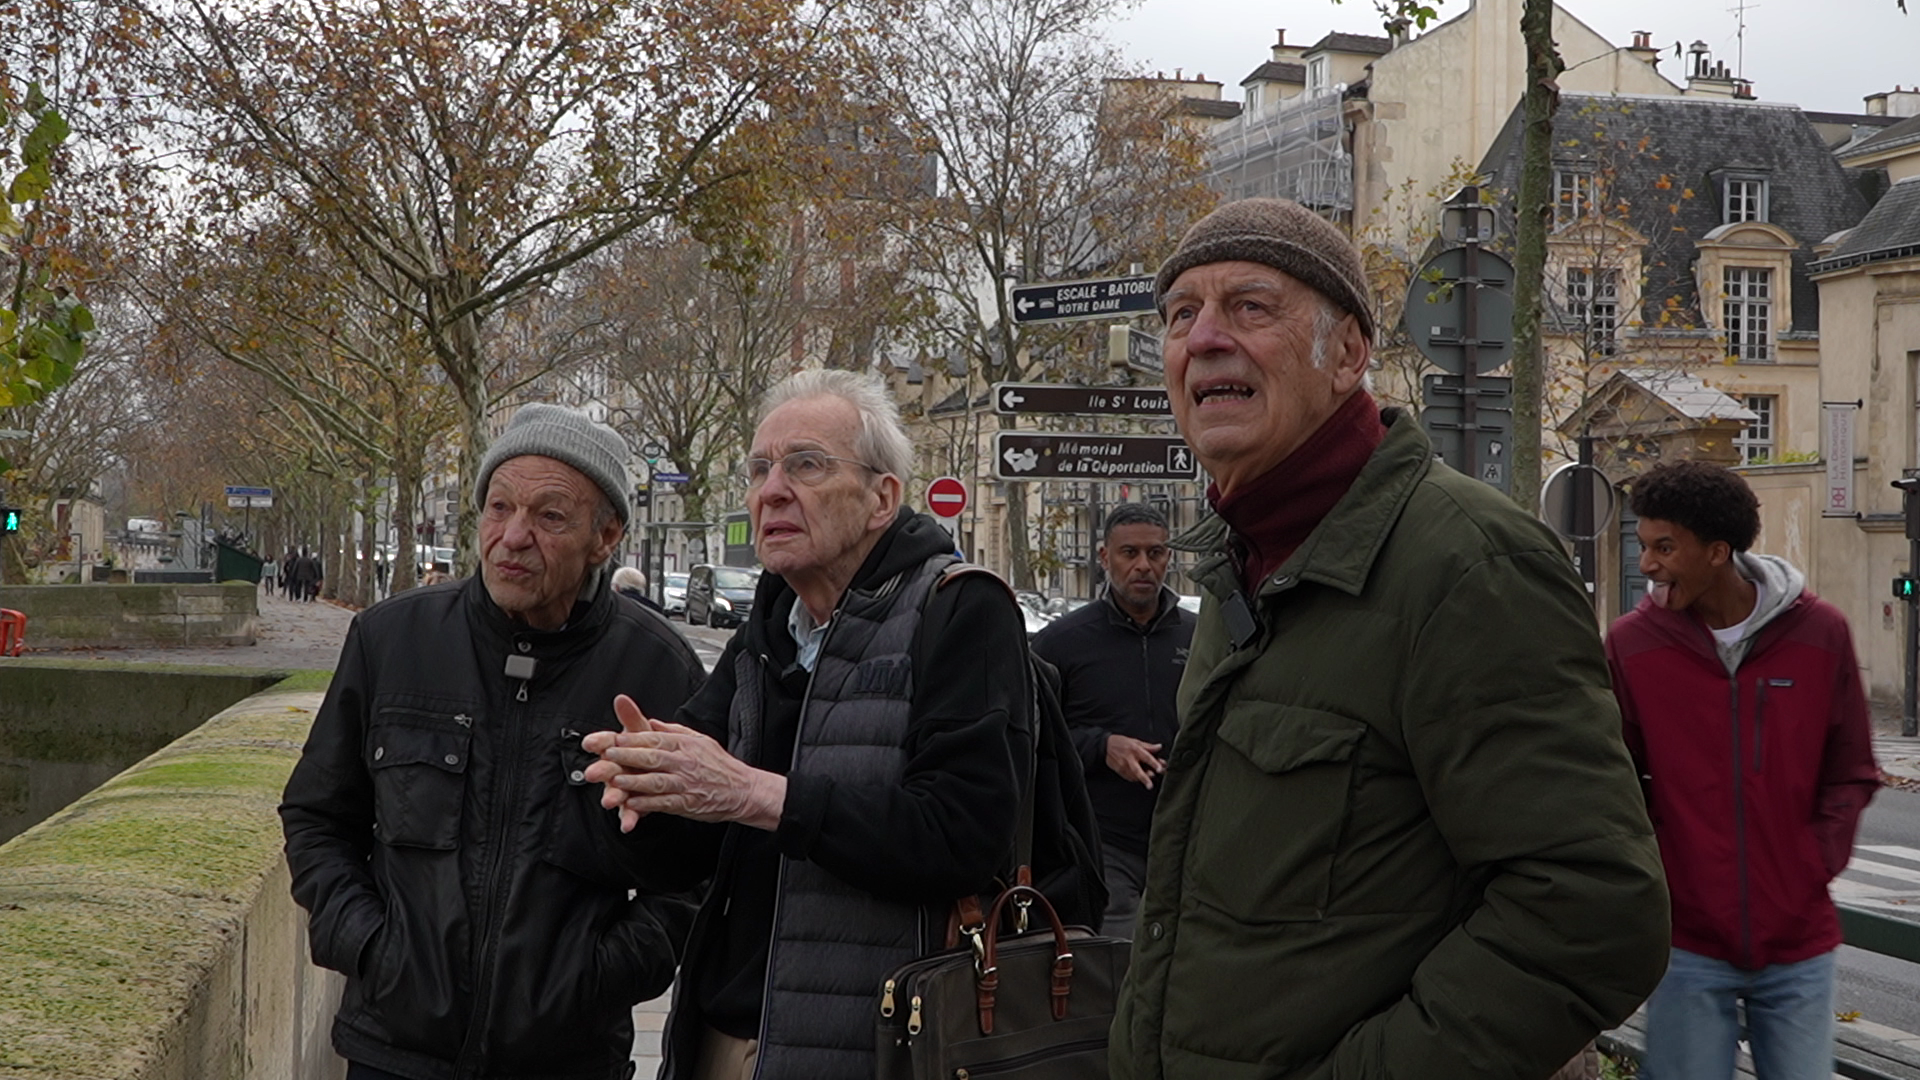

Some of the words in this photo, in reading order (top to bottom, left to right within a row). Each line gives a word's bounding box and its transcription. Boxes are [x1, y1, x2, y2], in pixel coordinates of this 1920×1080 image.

[1057, 286, 1097, 301] ESCALE
[1108, 281, 1155, 296] BATOBU
[1058, 302, 1089, 314] NOTRE
[1092, 299, 1120, 311] DAME
[1089, 395, 1106, 408] Ile
[1111, 395, 1126, 408] St
[1134, 396, 1169, 409] Louis
[1058, 442, 1123, 455] Mémorial
[1058, 460, 1073, 472] de
[1077, 460, 1088, 472] la
